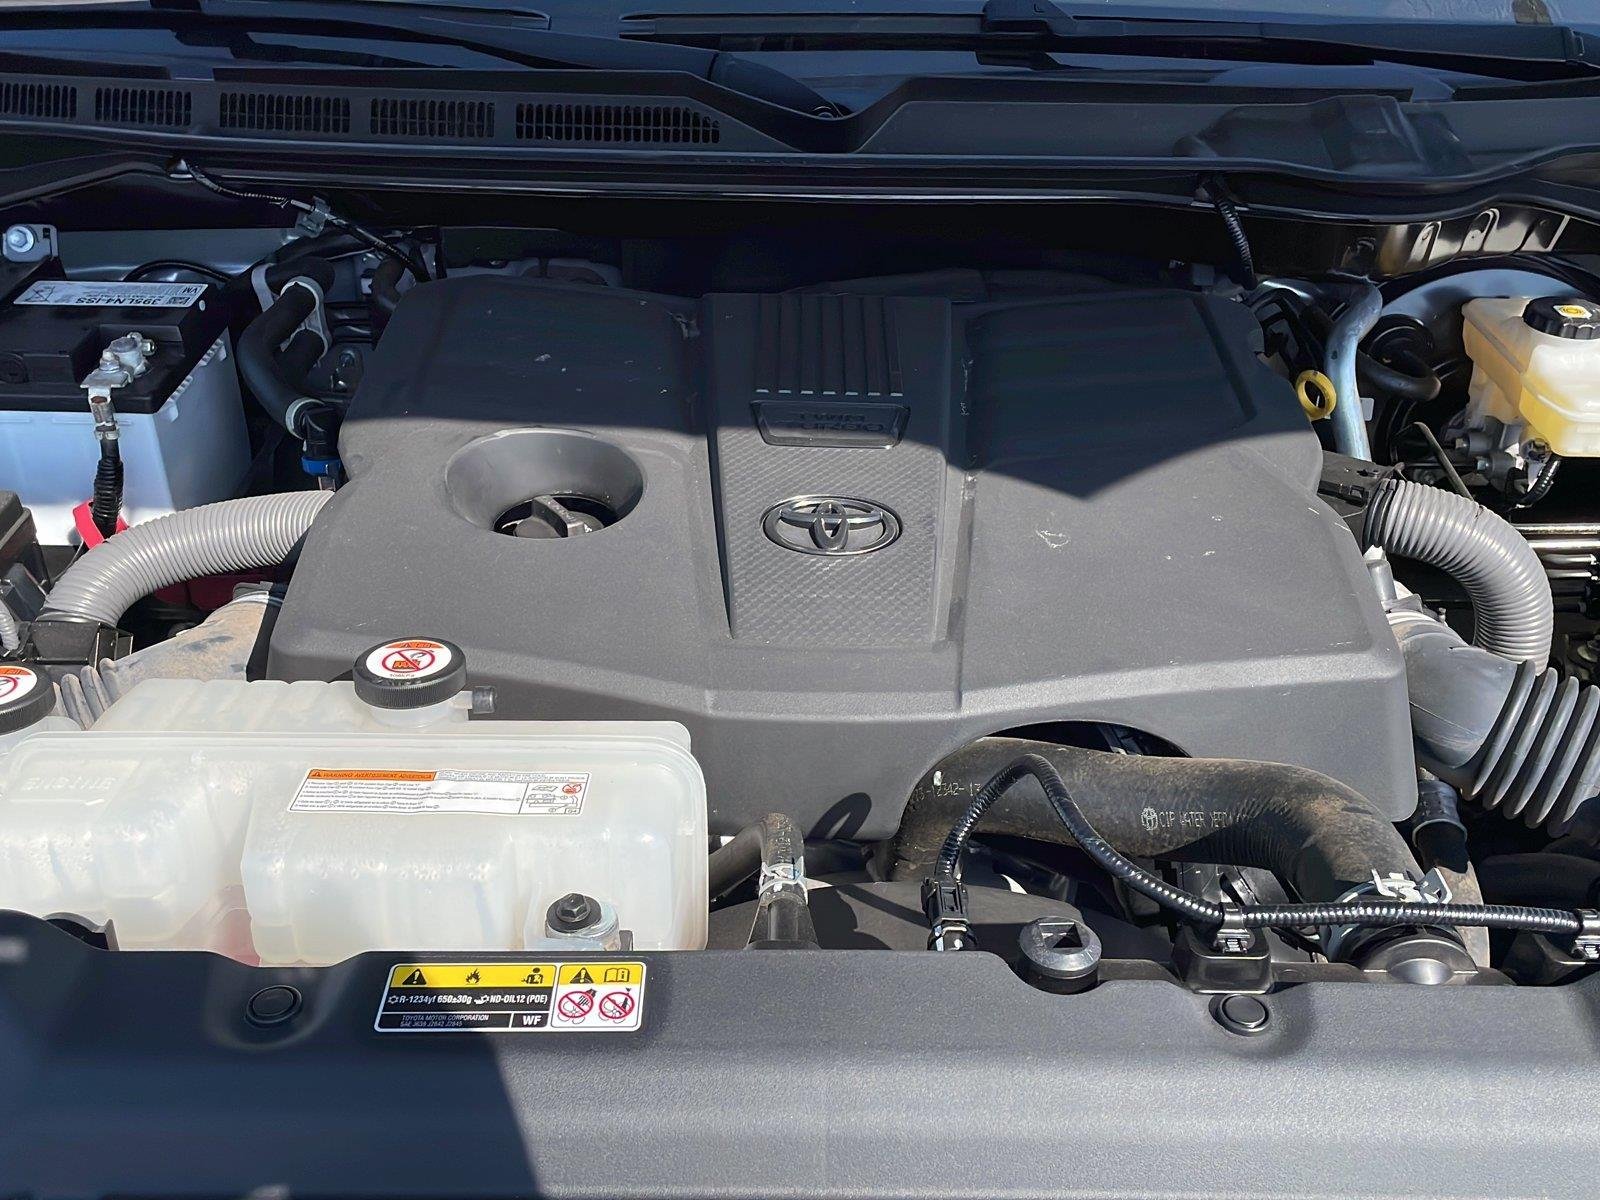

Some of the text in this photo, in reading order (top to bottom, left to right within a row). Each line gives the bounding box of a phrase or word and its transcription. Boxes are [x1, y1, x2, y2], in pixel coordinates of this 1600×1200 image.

[399, 994, 548, 1005] R-1234yf 650±30g ND-OIL12 (POE)
[522, 1015, 542, 1025] WF
